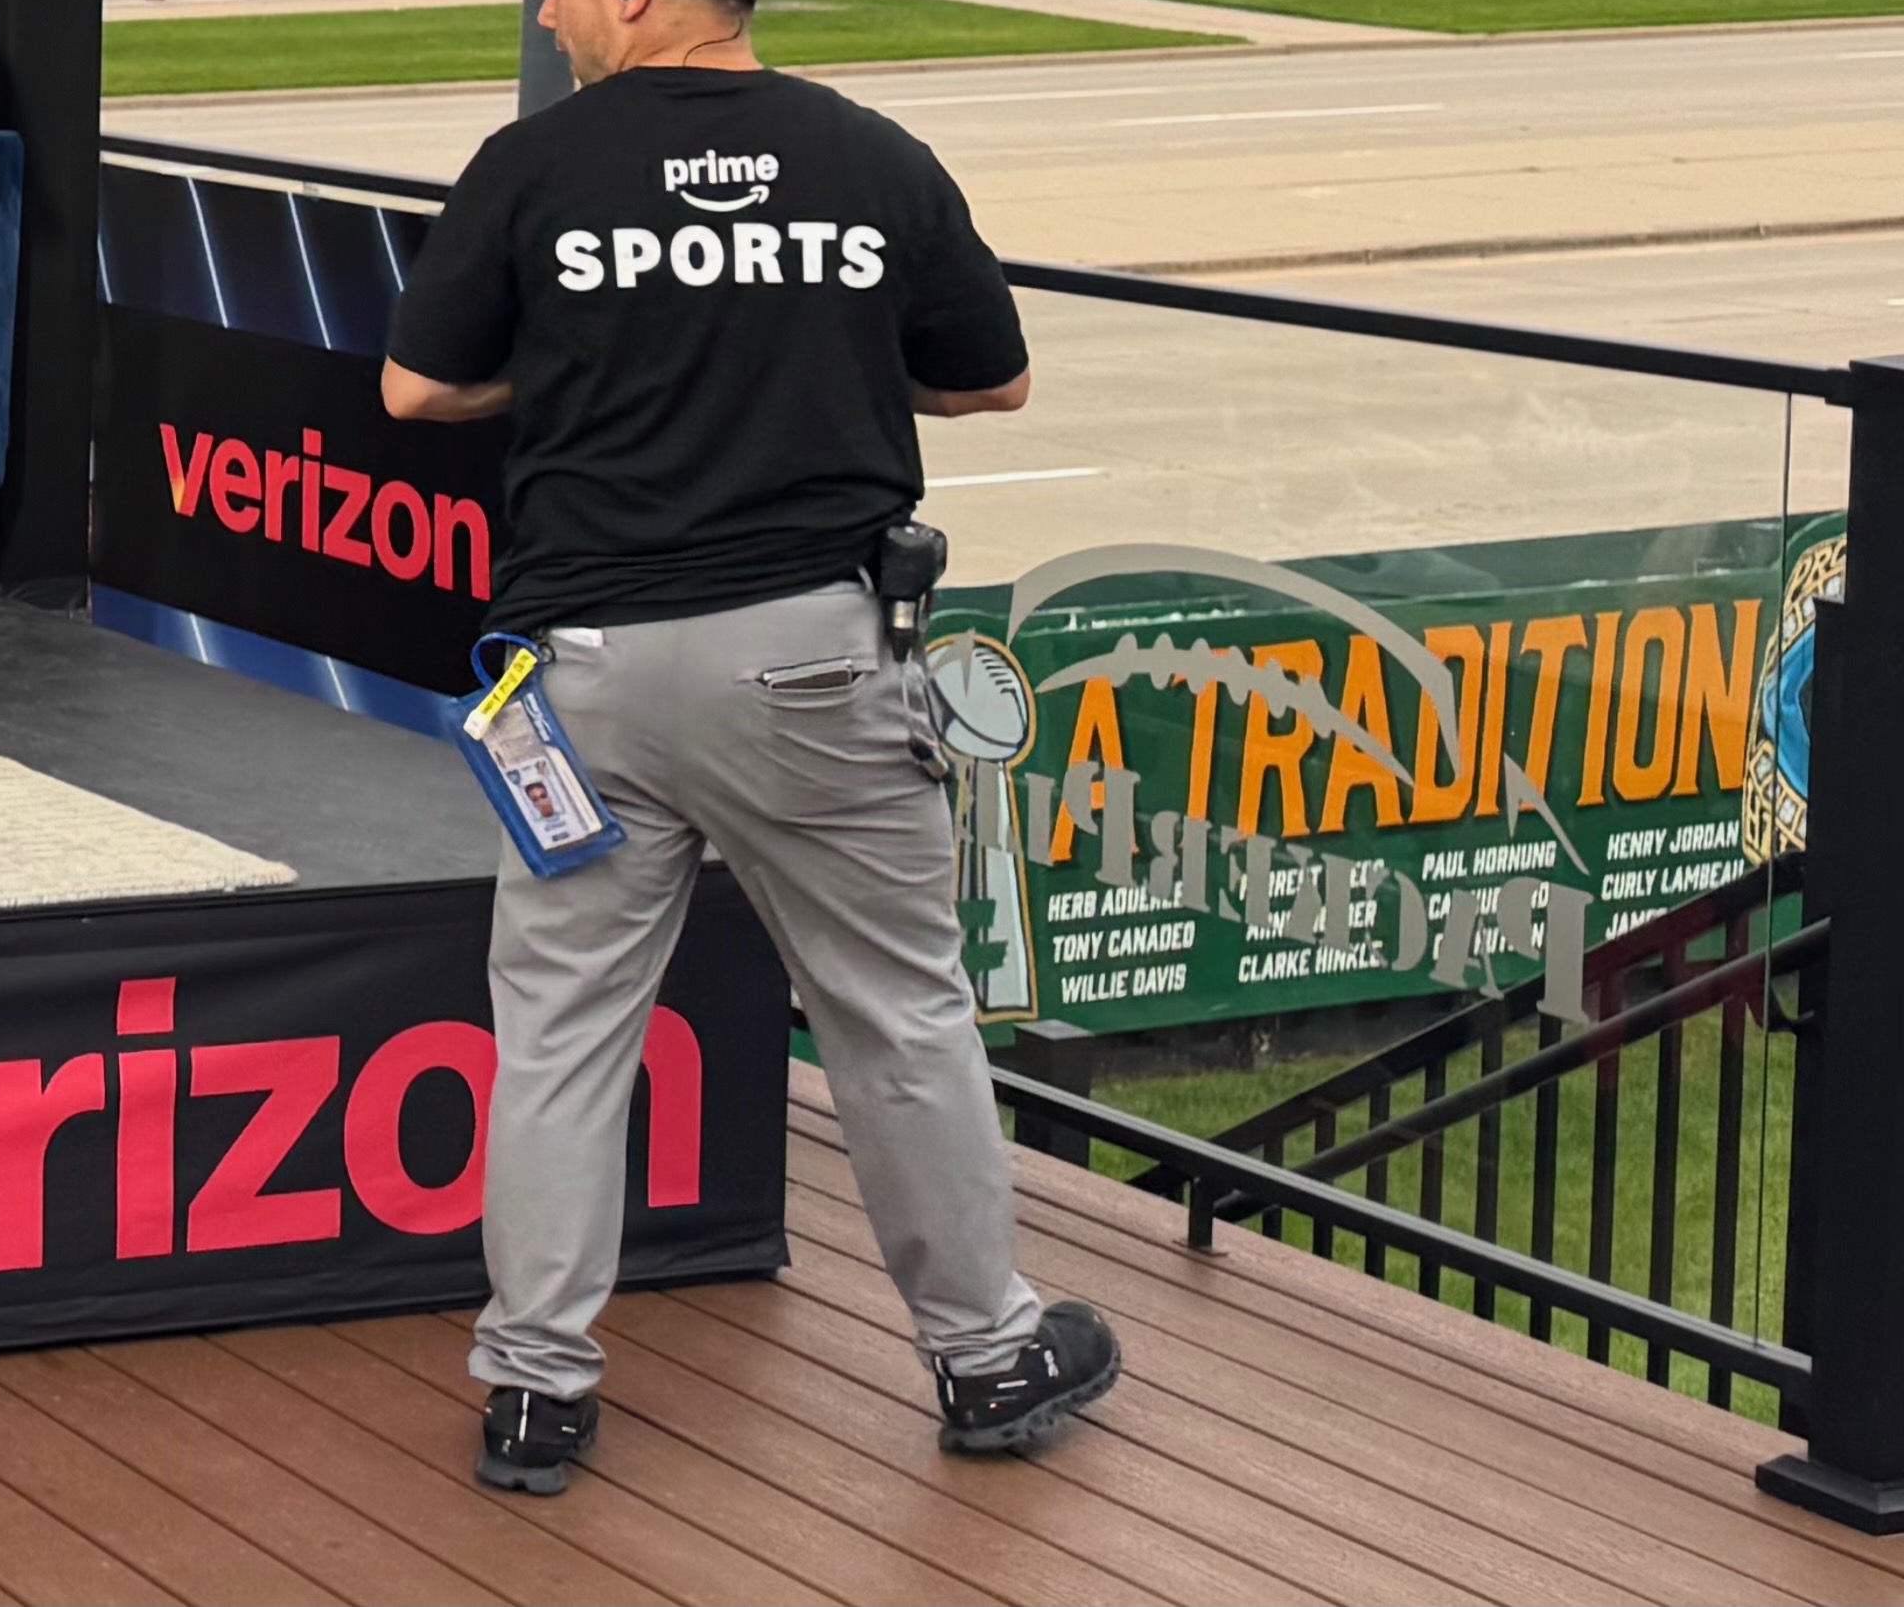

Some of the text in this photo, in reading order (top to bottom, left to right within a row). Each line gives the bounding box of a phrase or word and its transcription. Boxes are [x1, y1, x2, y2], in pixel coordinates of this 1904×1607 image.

[663, 150, 780, 192] prime
[555, 222, 887, 292] SPORTS
[159, 422, 491, 602] verizon
[1050, 672, 1141, 862] A
[1172, 598, 1763, 842] TRADITION
[1422, 850, 1468, 881] PAUL
[1473, 840, 1557, 876] HORNUNG
[1607, 819, 1740, 861] HENRY JORDAN
[1601, 868, 1658, 901] CURLY
[1048, 891, 1098, 922] HERB
[1053, 920, 1196, 964] TONY CANADEO
[1061, 963, 1187, 1004] WILLIE DAVIS
[1238, 948, 1312, 983] CLARKE
